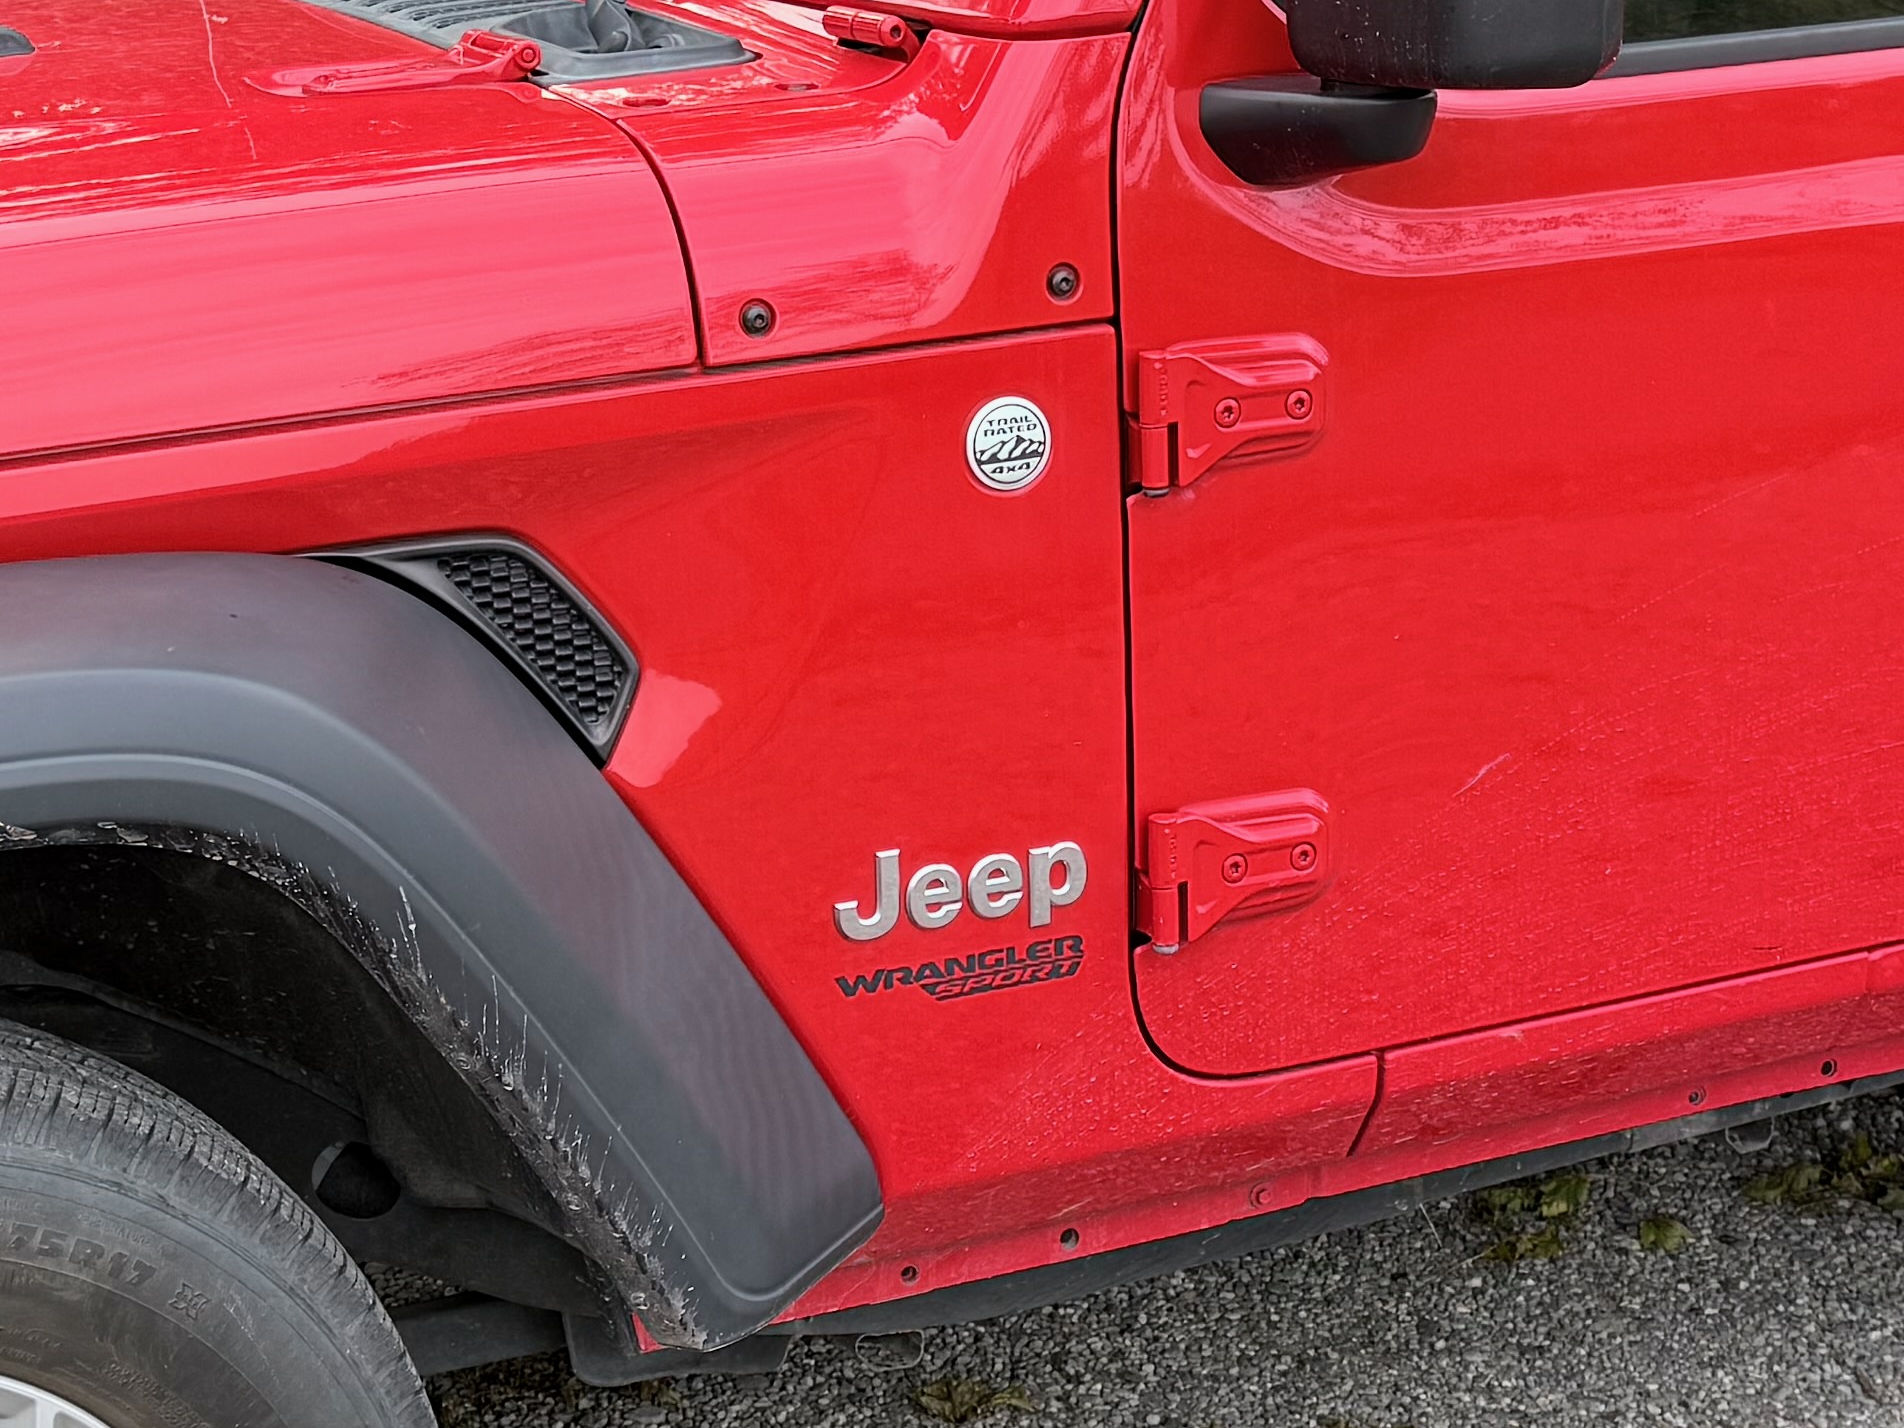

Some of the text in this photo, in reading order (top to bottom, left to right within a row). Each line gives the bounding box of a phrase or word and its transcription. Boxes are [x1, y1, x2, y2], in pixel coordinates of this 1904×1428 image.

[984, 423, 1037, 437] RATED
[986, 415, 1033, 427] TRAIL
[833, 840, 1089, 942] Jeep
[834, 935, 1084, 998] WRANGLER
[932, 960, 1082, 998] SPORT
